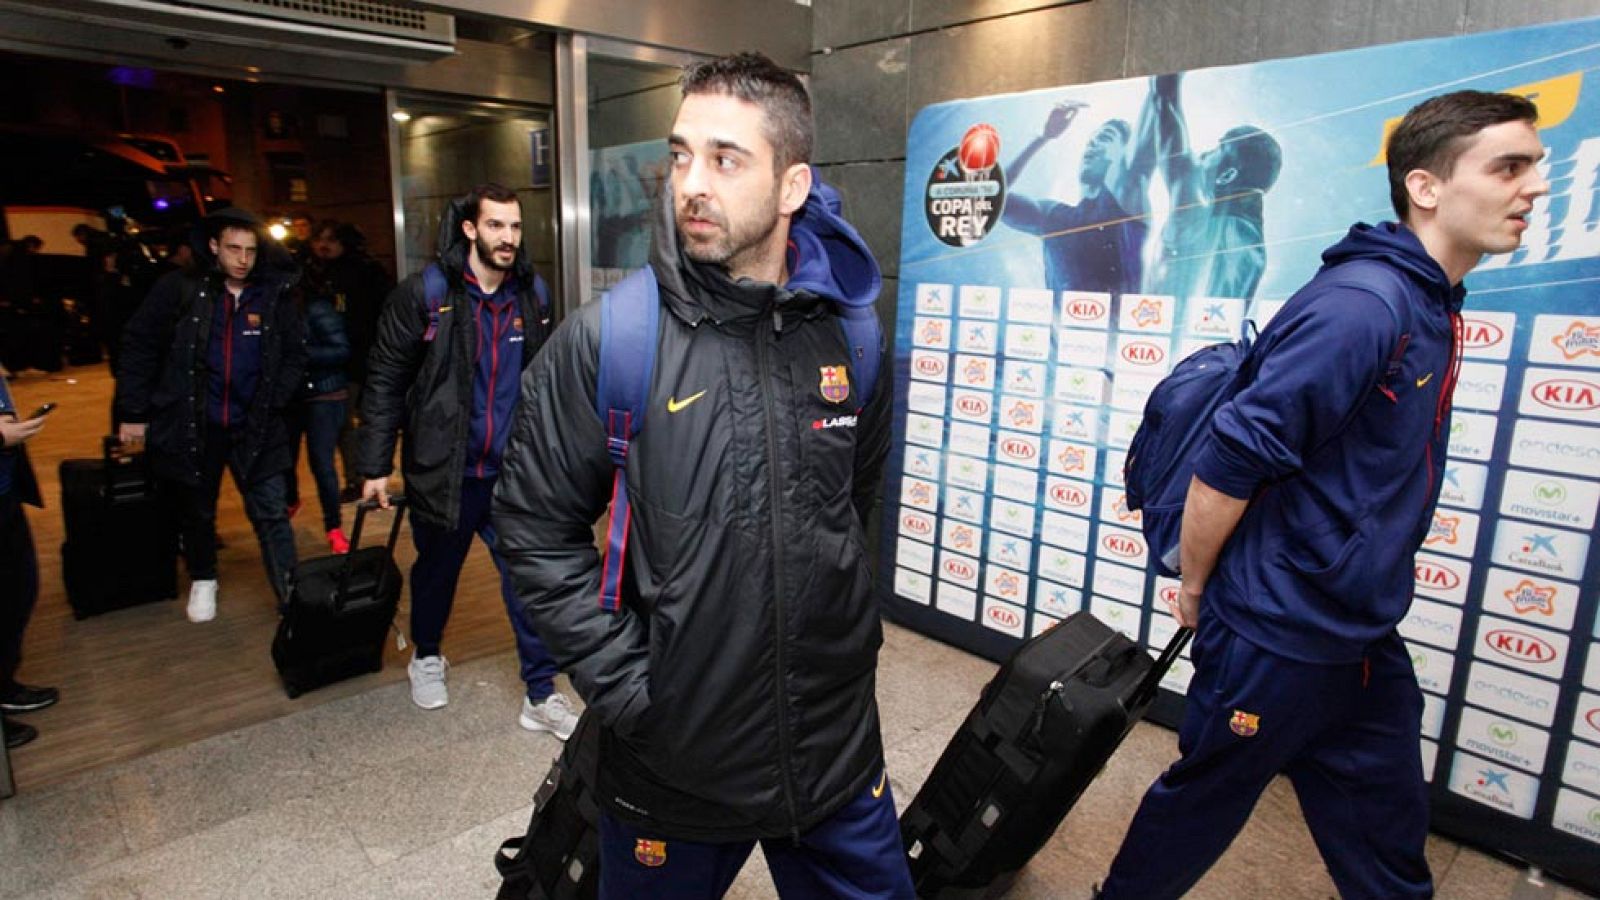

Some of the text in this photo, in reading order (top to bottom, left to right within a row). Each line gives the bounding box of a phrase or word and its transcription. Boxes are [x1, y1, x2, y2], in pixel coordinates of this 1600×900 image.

[931, 199, 973, 215] COPA
[941, 215, 989, 238] REY
[1544, 385, 1594, 405] KIA
[1496, 633, 1542, 659] KIA
